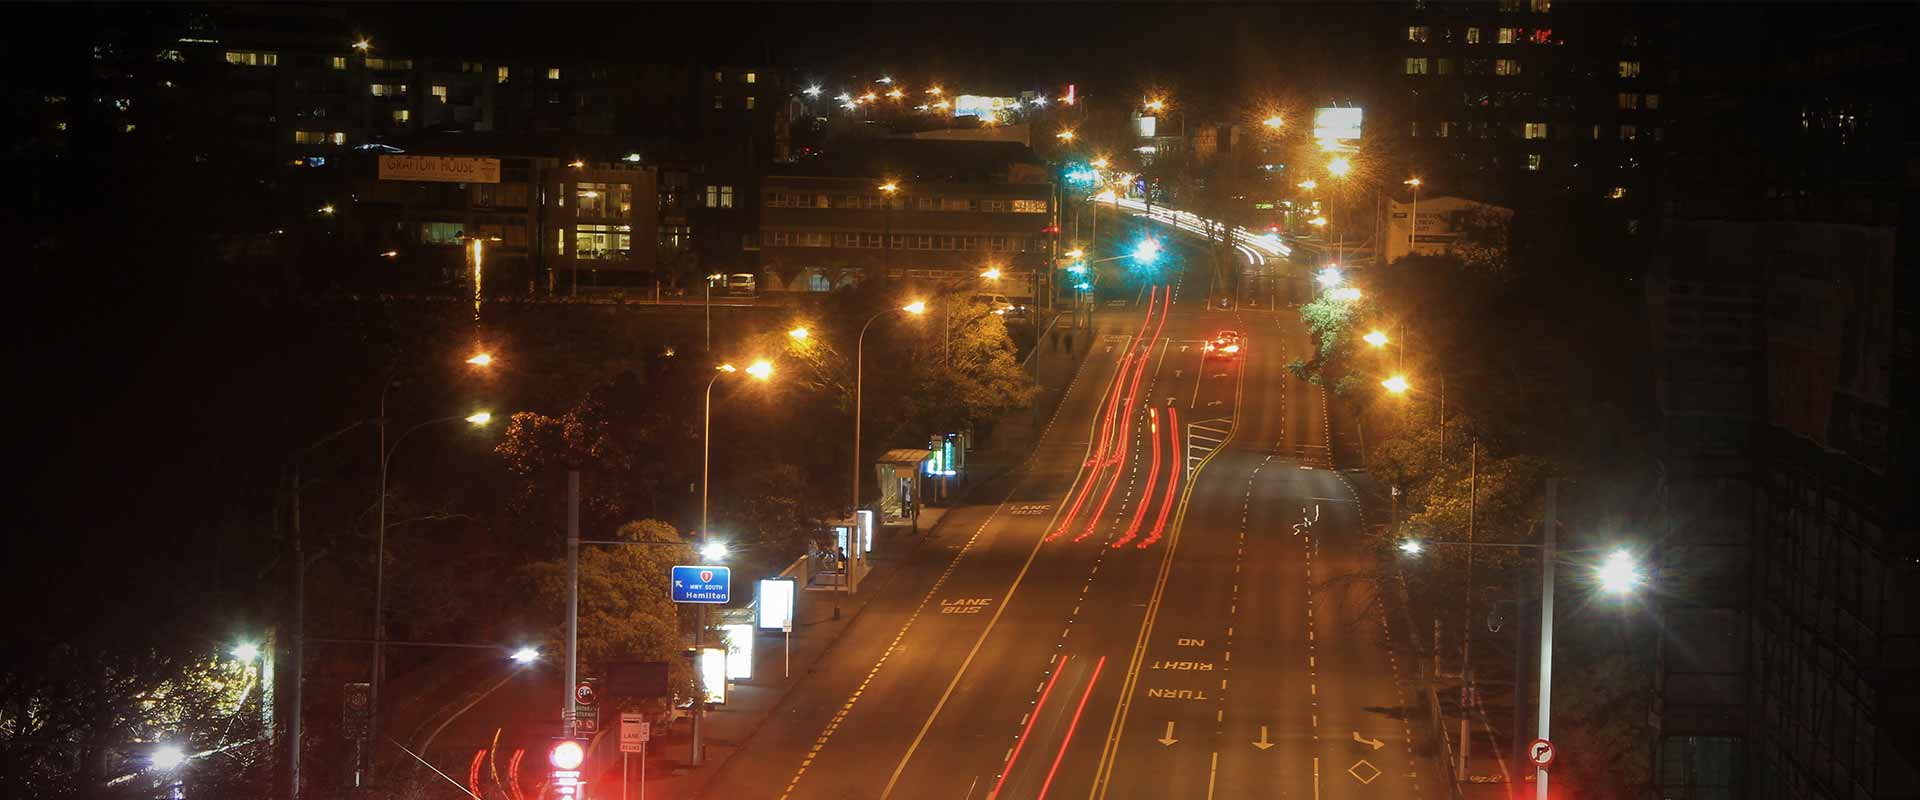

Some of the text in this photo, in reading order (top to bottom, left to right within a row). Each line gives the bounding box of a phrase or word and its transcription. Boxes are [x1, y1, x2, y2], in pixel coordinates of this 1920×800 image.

[387, 158, 474, 173] GRAFTON HOUSE
[940, 598, 992, 606] LANE
[940, 606, 982, 614] BUS
[1177, 638, 1205, 647] NO
[1152, 661, 1214, 671] RIGHT
[1148, 688, 1208, 700] TURN
